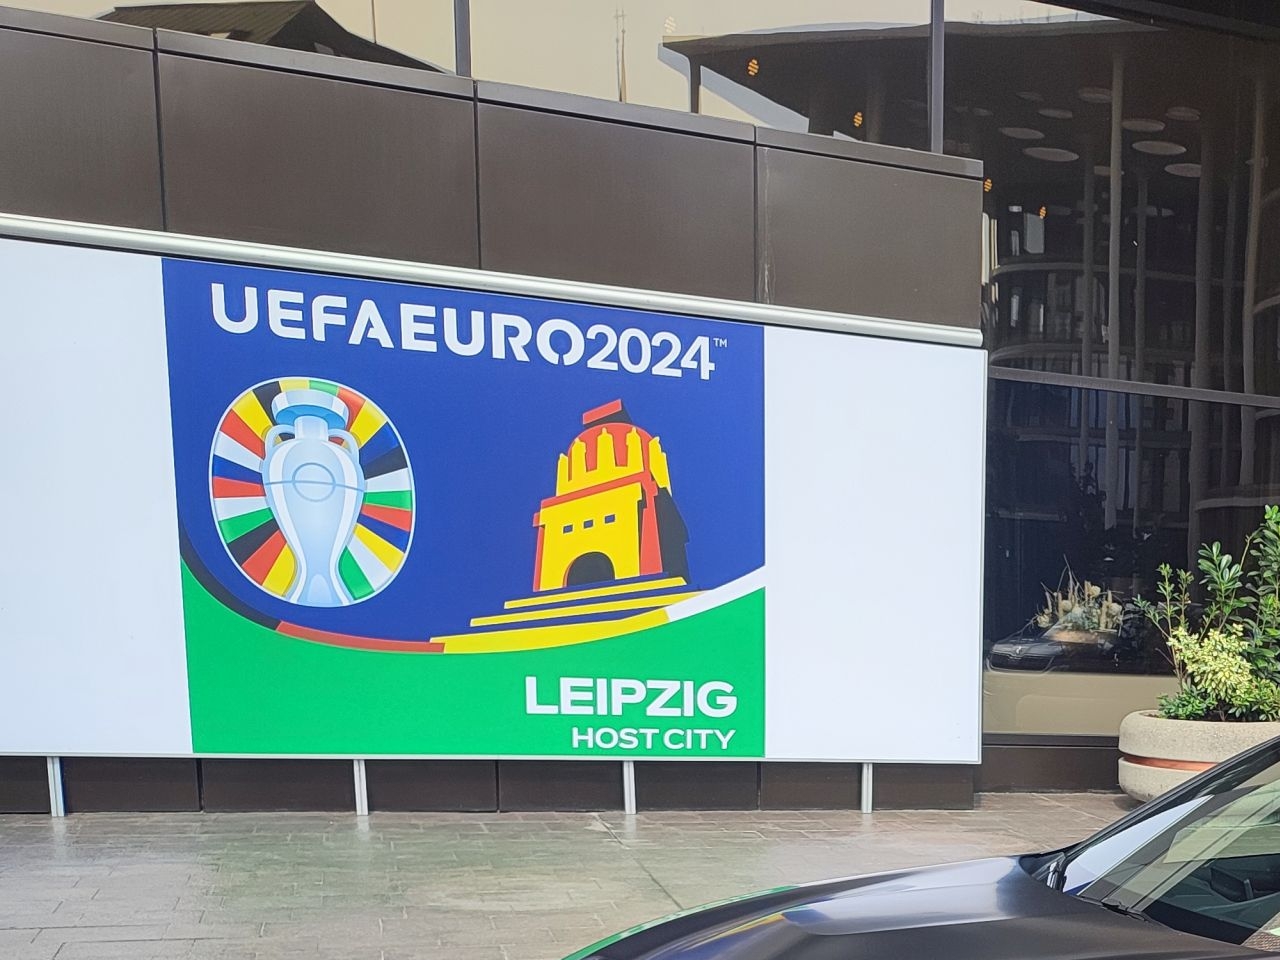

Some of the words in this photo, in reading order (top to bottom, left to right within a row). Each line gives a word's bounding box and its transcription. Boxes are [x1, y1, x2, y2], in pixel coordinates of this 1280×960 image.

[525, 676, 737, 718] LEIPZIG
[572, 727, 660, 749] HOST
[663, 728, 736, 750] CITY
